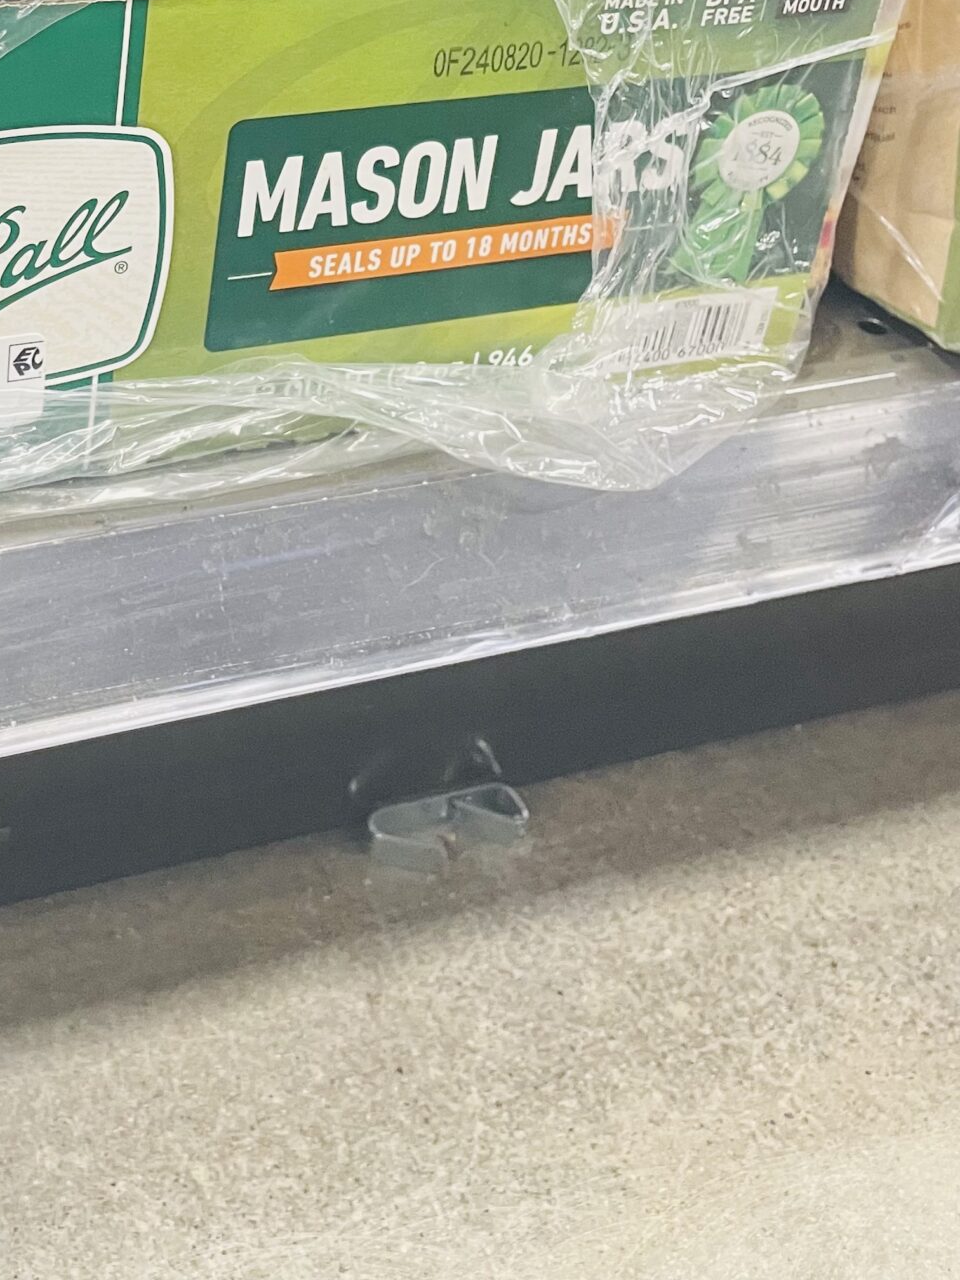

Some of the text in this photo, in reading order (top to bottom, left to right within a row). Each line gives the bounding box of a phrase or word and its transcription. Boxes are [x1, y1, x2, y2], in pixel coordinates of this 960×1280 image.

[597, 9, 678, 36] U.S.A.
[700, 6, 754, 28] FREE
[509, 120, 686, 208] JARS
[236, 133, 499, 239] MASON
[307, 223, 593, 280] SEALS UP TO 18 MONTHS
[487, 344, 535, 367] 946
